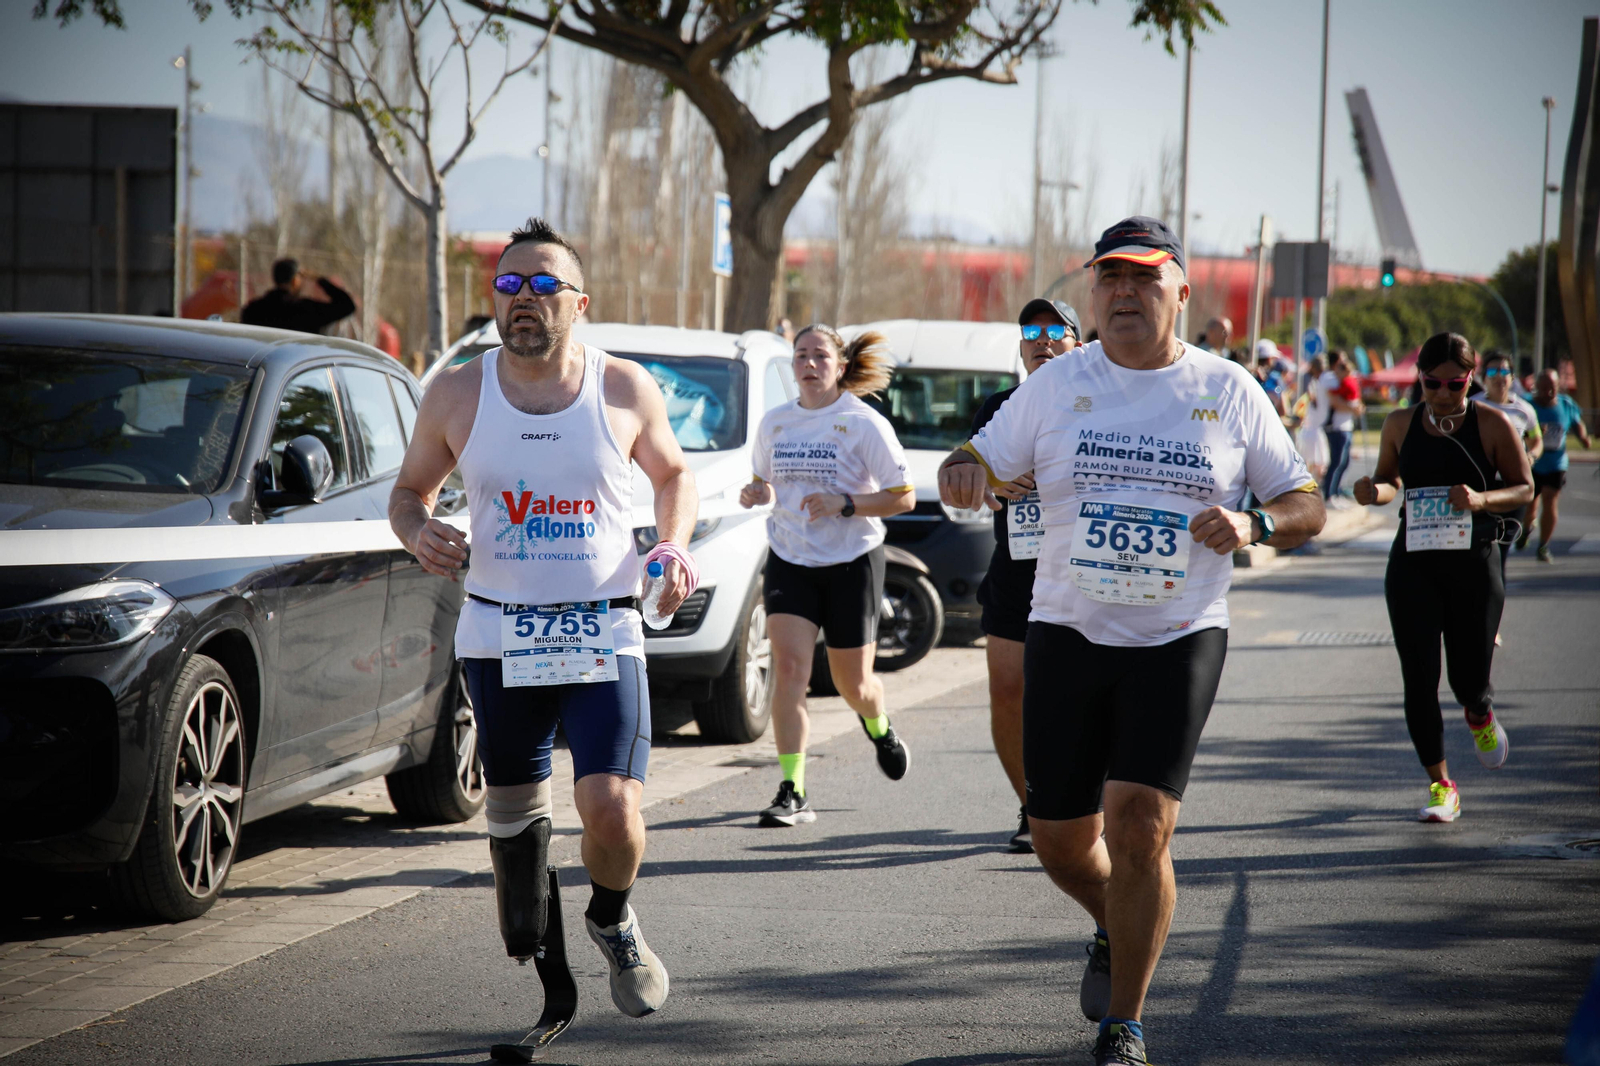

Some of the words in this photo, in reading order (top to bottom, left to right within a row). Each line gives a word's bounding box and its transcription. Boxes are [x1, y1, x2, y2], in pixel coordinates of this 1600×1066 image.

[799, 442, 837, 450] Maratón
[1078, 429, 1131, 444] Medio
[1139, 435, 1212, 454] Maratón
[773, 449, 806, 459] Almería
[807, 449, 837, 459] 2024
[1075, 441, 1154, 462] Almería
[1158, 450, 1213, 471] 2024
[1074, 461, 1118, 472] RAMÓN
[1123, 466, 1152, 475] RUIZ
[1156, 469, 1215, 485] ANDÚJAR
[501, 491, 595, 525] Valero
[1014, 503, 1041, 524] 59
[1112, 510, 1135, 519] Almería
[526, 517, 595, 540] Alonso
[1085, 519, 1177, 557] 5633
[494, 552, 529, 560] HELADOS
[538, 552, 598, 561] CONGELADOS
[1117, 552, 1139, 562] SEVI
[514, 612, 601, 638] 5755
[534, 635, 582, 644] MIGUELON
